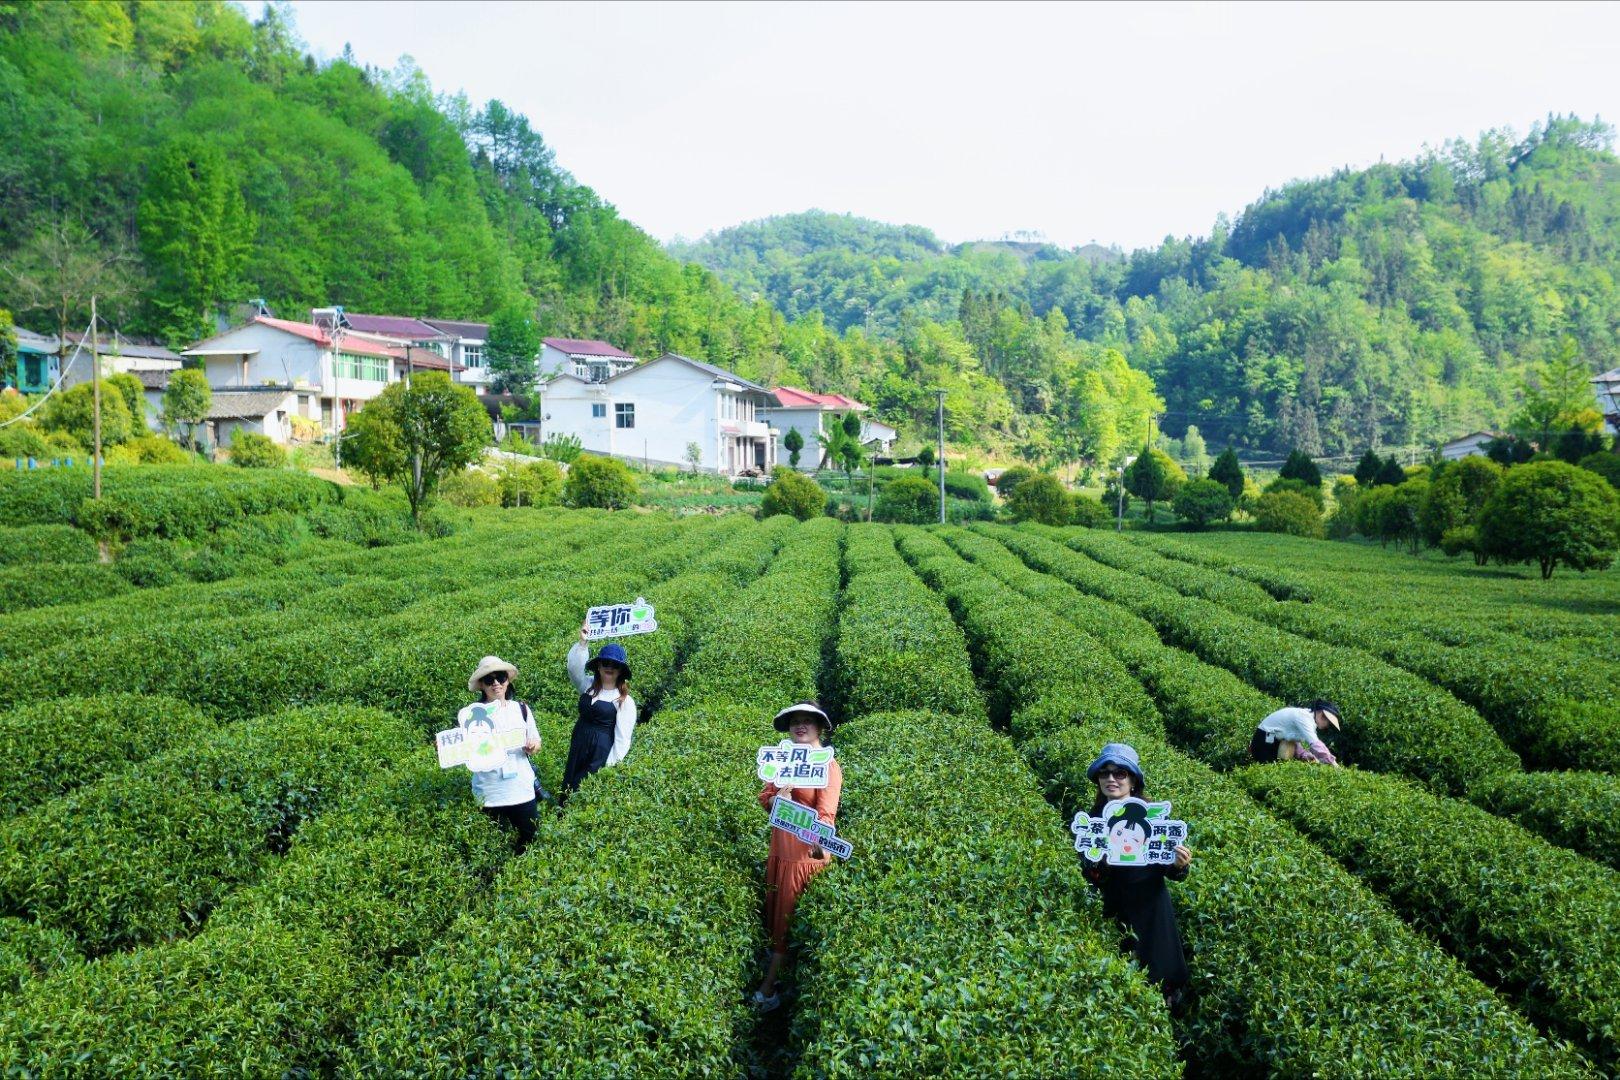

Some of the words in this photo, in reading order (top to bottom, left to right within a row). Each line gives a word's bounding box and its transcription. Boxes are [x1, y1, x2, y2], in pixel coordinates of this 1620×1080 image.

[590, 608, 631, 627] 等你
[762, 748, 807, 763] 不等风
[780, 764, 824, 778] 去追风
